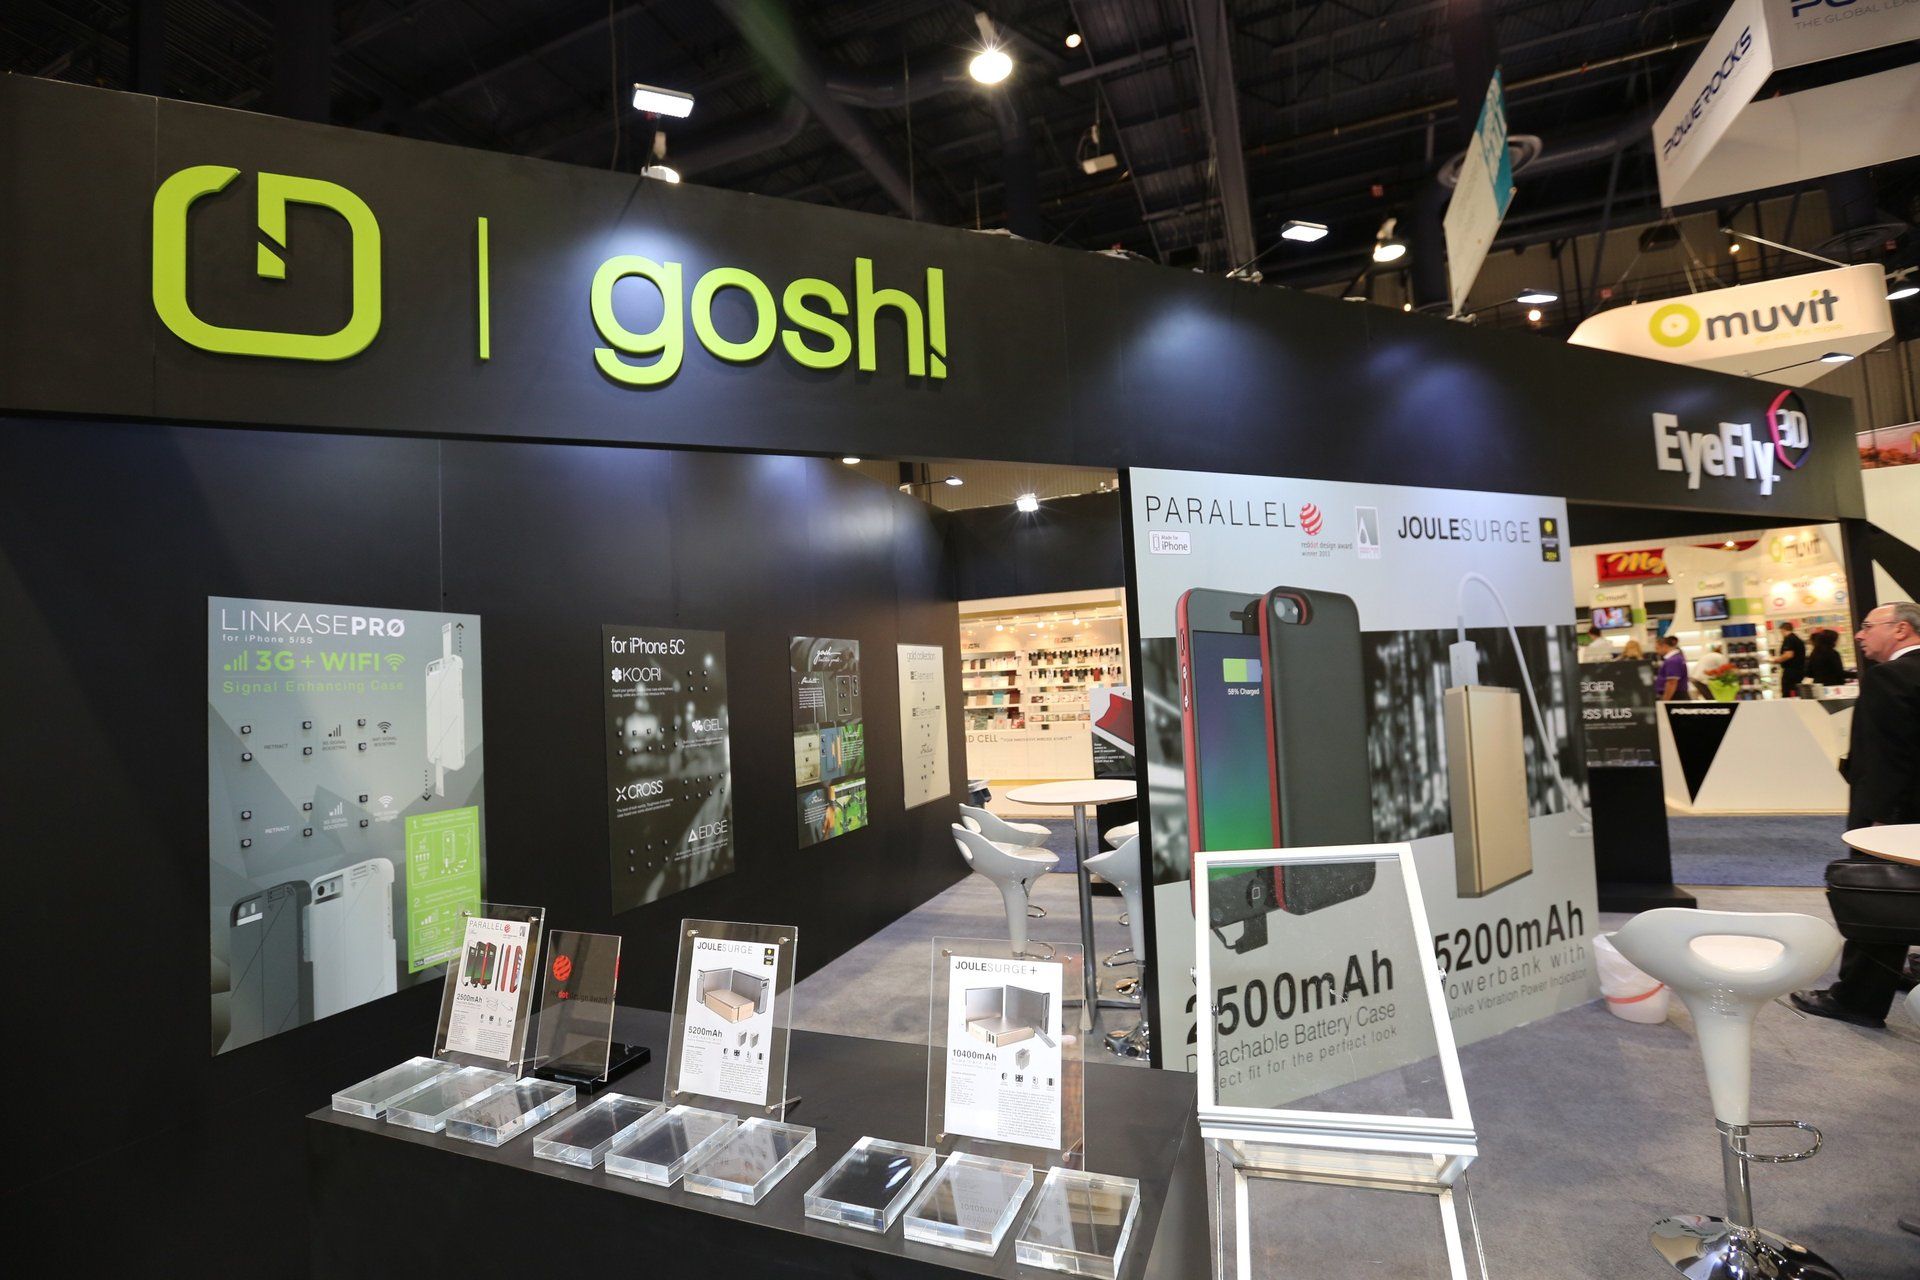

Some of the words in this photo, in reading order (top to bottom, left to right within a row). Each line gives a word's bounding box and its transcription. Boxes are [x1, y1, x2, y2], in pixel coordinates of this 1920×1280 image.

[590, 254, 947, 386] gosh!
[1706, 289, 1839, 341] muvit
[1146, 495, 1296, 528] PARALLEL
[1398, 515, 1531, 543] JOULESURGE
[1161, 541, 1189, 551] iPhone
[222, 633, 240, 642] for
[244, 633, 285, 644] iPhone
[610, 636, 627, 654] for
[629, 637, 668, 655] iPhone
[669, 638, 686, 655] 5C
[255, 649, 296, 673] 3G
[319, 651, 381, 673] WIFI
[622, 667, 662, 682] KOORI
[223, 680, 279, 696] Signal
[285, 679, 366, 695] Enhancing
[370, 679, 405, 692] Case
[1603, 707, 1632, 720] PLUS
[703, 718, 724, 732] GEL
[976, 734, 998, 743] CELL
[627, 780, 664, 800] CROSS
[698, 819, 728, 840] EDGE
[697, 941, 753, 955] JOULESURGE
[1434, 900, 1584, 976] 5200mAh
[955, 960, 1028, 975] JOULESURGE
[1443, 956, 1542, 1000] owerbank
[1550, 944, 1585, 968] with
[1185, 949, 1394, 1045] 2500mAh
[1478, 989, 1519, 1010] Vibration
[1520, 980, 1548, 996] Power
[1549, 968, 1588, 986] Indicator
[688, 1025, 723, 1038] 5200mAh
[1186, 1031, 1290, 1074] Dachable
[1294, 1016, 1352, 1047] Battery
[1356, 1002, 1396, 1027] Case
[952, 1049, 997, 1061] 10400mAh
[1248, 1065, 1263, 1081] fit
[1267, 1060, 1287, 1076] for
[1292, 1049, 1315, 1068] the
[1319, 1034, 1367, 1062] perfect
[1370, 1025, 1399, 1043] look
